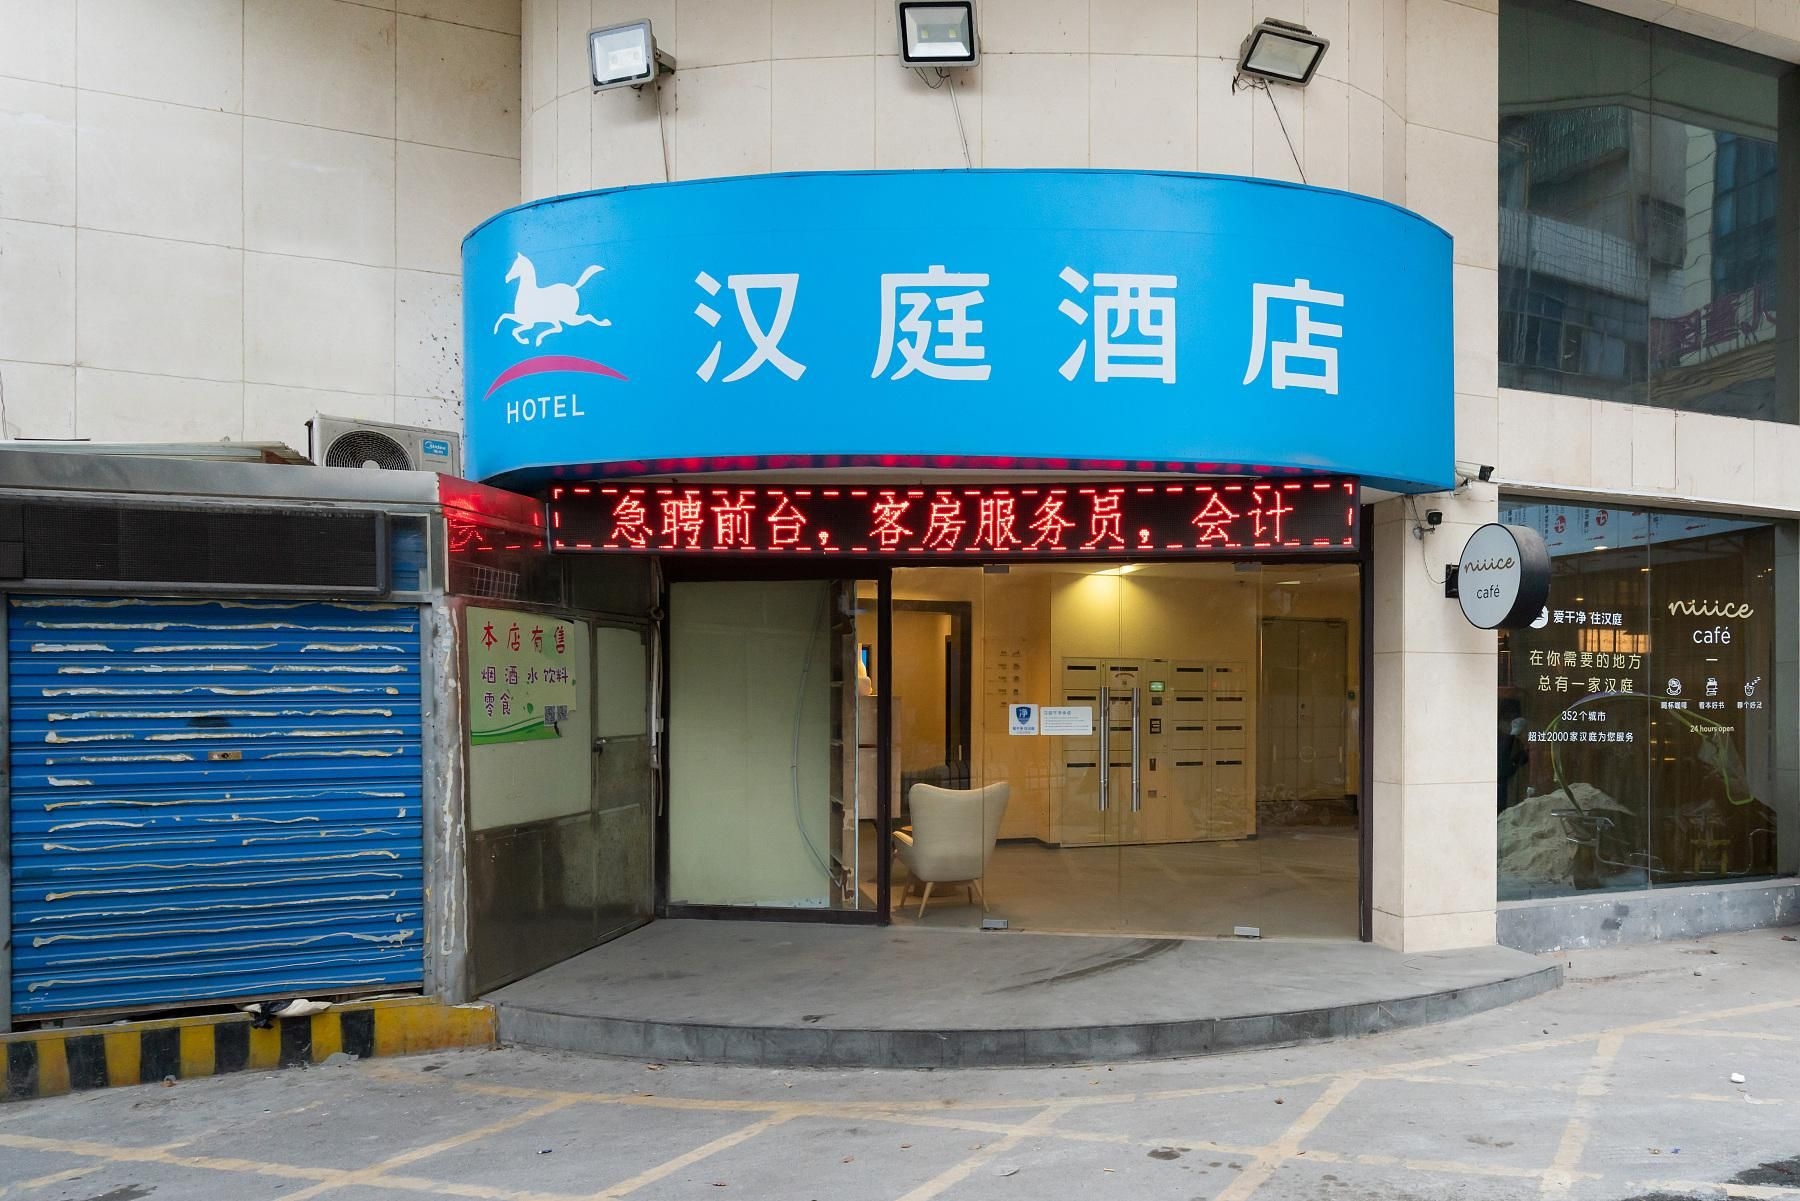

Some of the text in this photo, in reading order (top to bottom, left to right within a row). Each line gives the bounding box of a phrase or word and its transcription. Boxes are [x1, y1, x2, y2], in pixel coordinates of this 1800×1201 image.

[694, 265, 1345, 396] 汉庭酒店
[506, 393, 585, 425] HOTEL
[1464, 557, 1516, 574] niiice
[1476, 584, 1500, 599] café
[1553, 610, 1623, 626] 爱干净 住汉庭
[1667, 599, 1754, 619] niiice
[481, 621, 566, 654] 本店有售
[1692, 626, 1731, 645] café
[1529, 649, 1642, 670] 在你需要的地方
[1537, 674, 1633, 694] 总有一家汉庭
[484, 692, 511, 717] 零食
[1561, 710, 1607, 722] 352个城市
[1527, 731, 1634, 743] 超过2000家汉庭为您服务
[1690, 725, 1735, 734] 24 hours open
